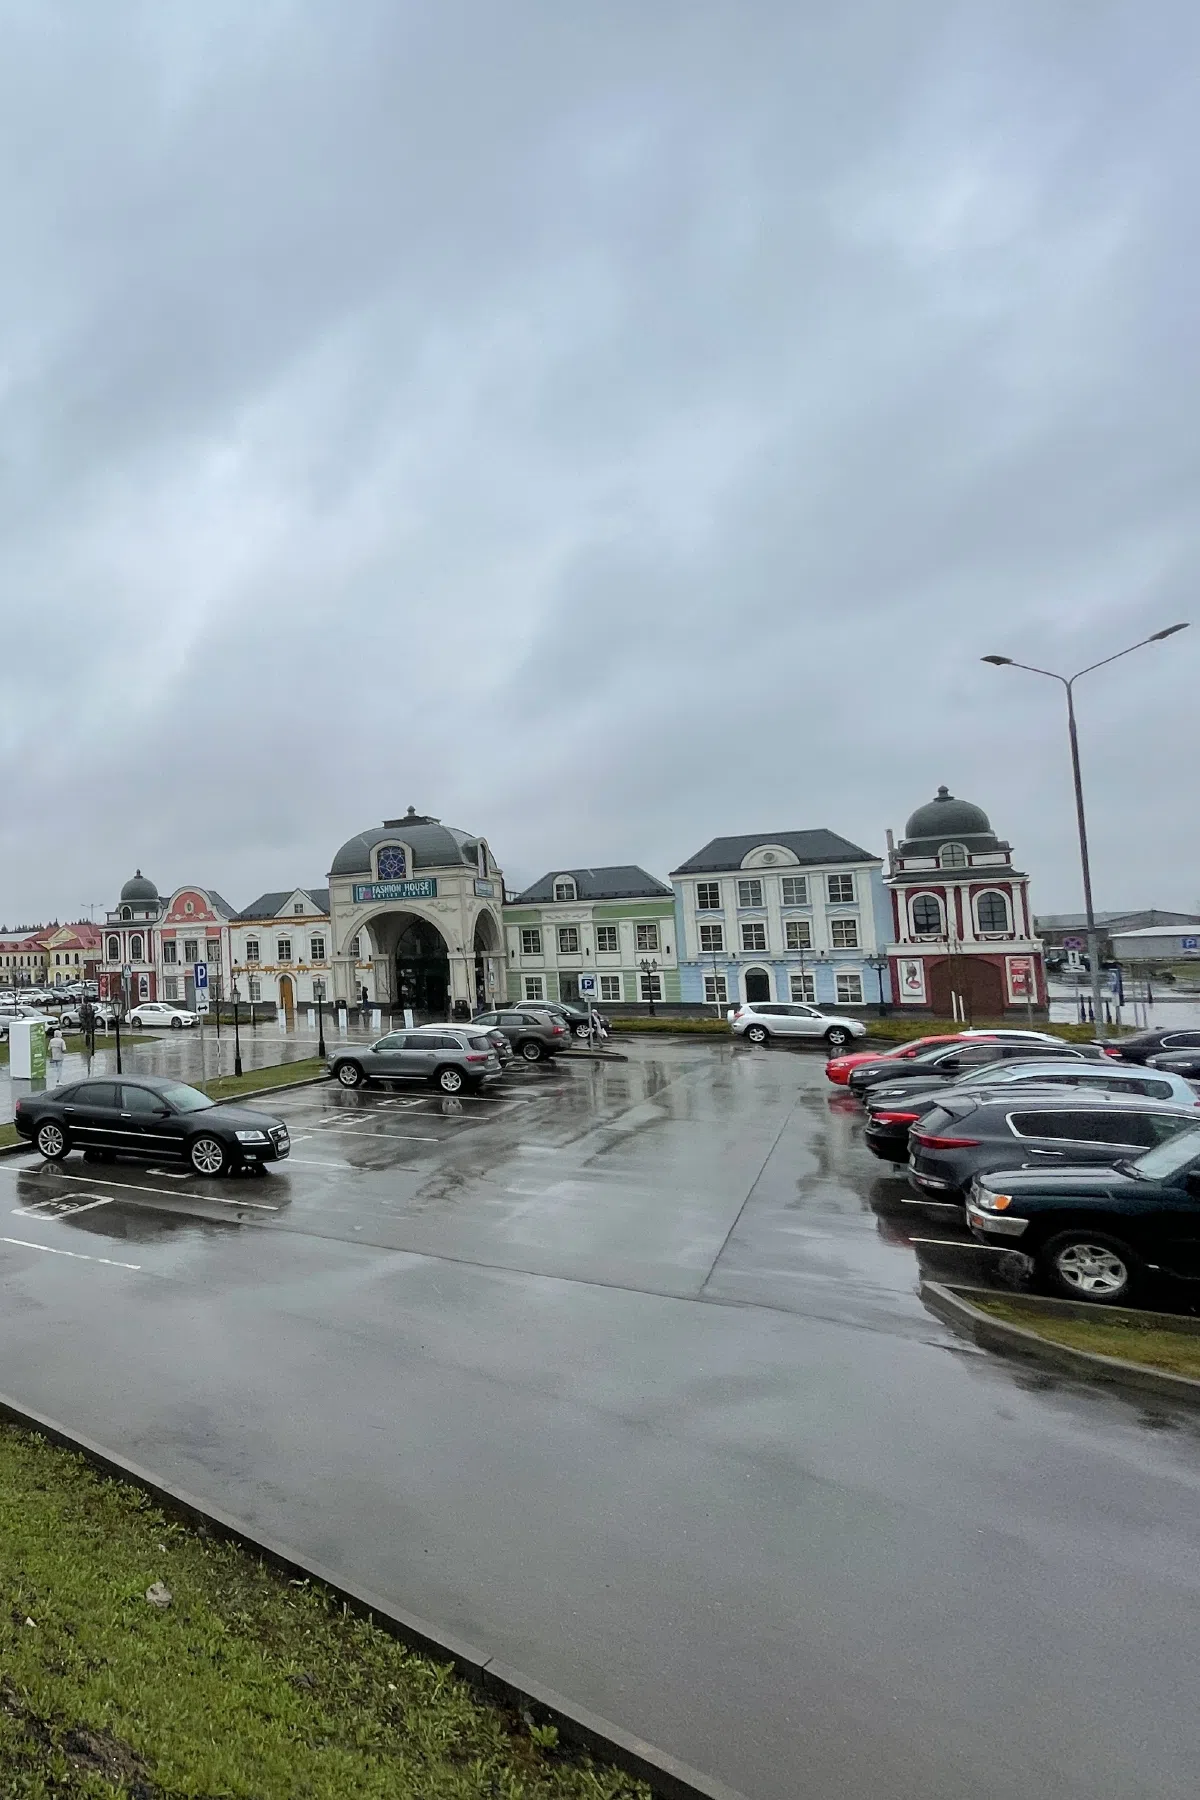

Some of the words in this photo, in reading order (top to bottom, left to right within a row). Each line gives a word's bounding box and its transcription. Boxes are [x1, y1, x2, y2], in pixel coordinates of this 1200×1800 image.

[372, 884, 401, 894] FASHION
[404, 882, 429, 891] HOUSE
[197, 965, 206, 987] P
[584, 979, 592, 989] P
